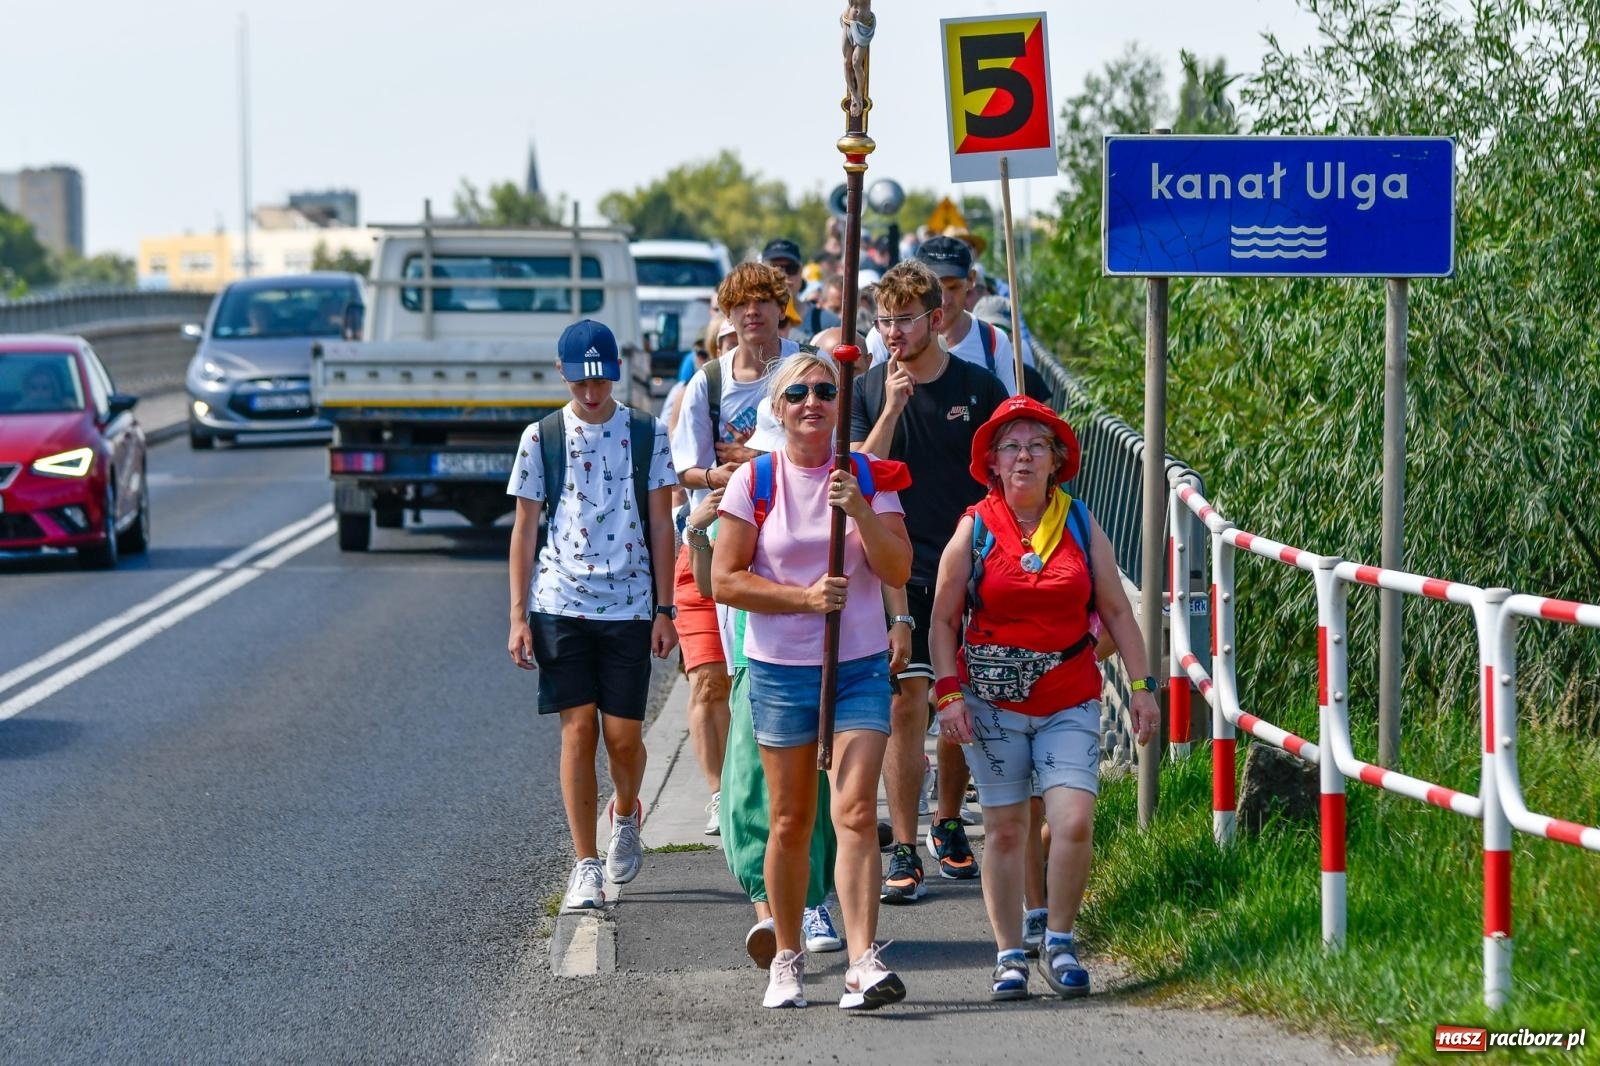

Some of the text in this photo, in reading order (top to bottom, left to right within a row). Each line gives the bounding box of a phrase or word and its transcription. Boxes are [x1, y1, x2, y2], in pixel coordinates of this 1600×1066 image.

[960, 32, 1034, 139] 5
[1151, 161, 1408, 211] kanał Ulga
